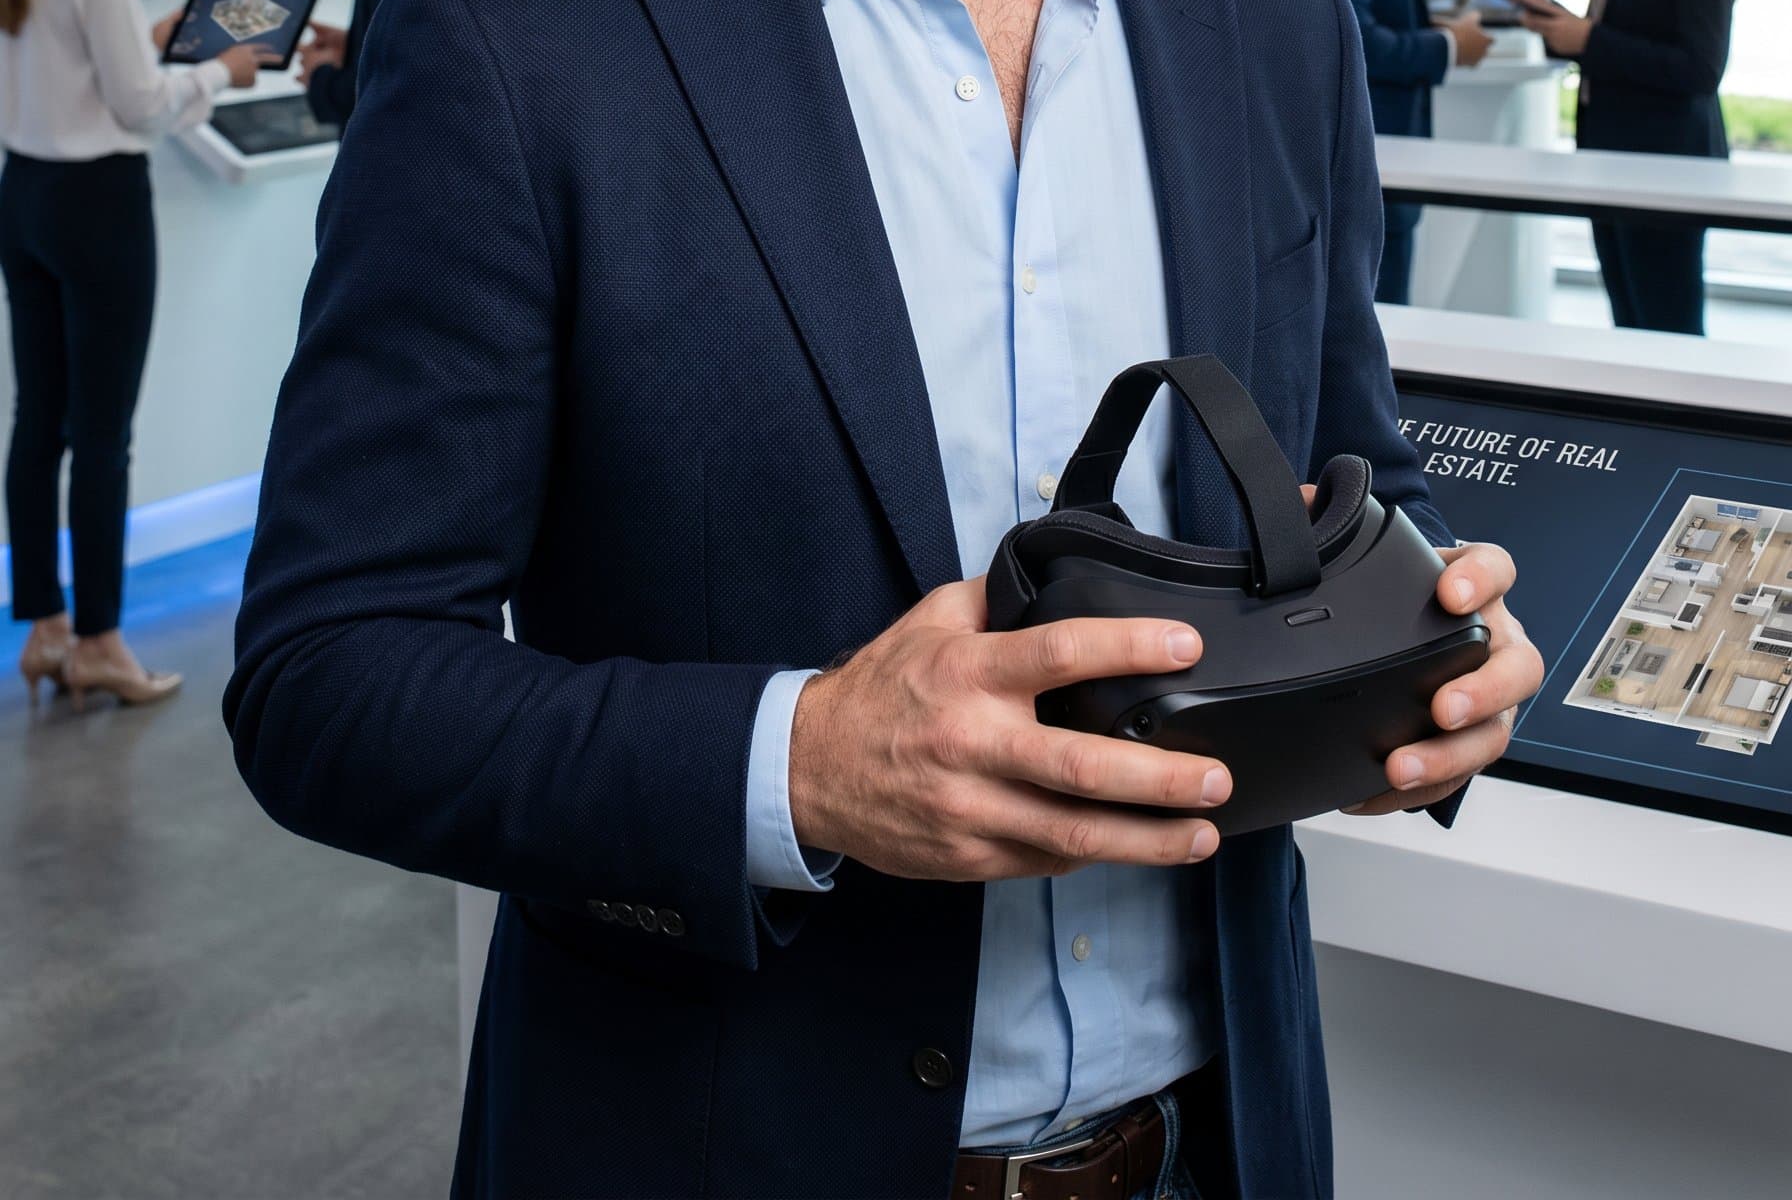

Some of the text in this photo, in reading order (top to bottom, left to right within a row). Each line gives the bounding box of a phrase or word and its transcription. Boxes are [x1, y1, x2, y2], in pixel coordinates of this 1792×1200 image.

[1415, 422, 1517, 456] FUTURE
[1518, 437, 1556, 460] OF
[1555, 442, 1620, 472] REAL
[1423, 452, 1520, 486] ESTATE.
